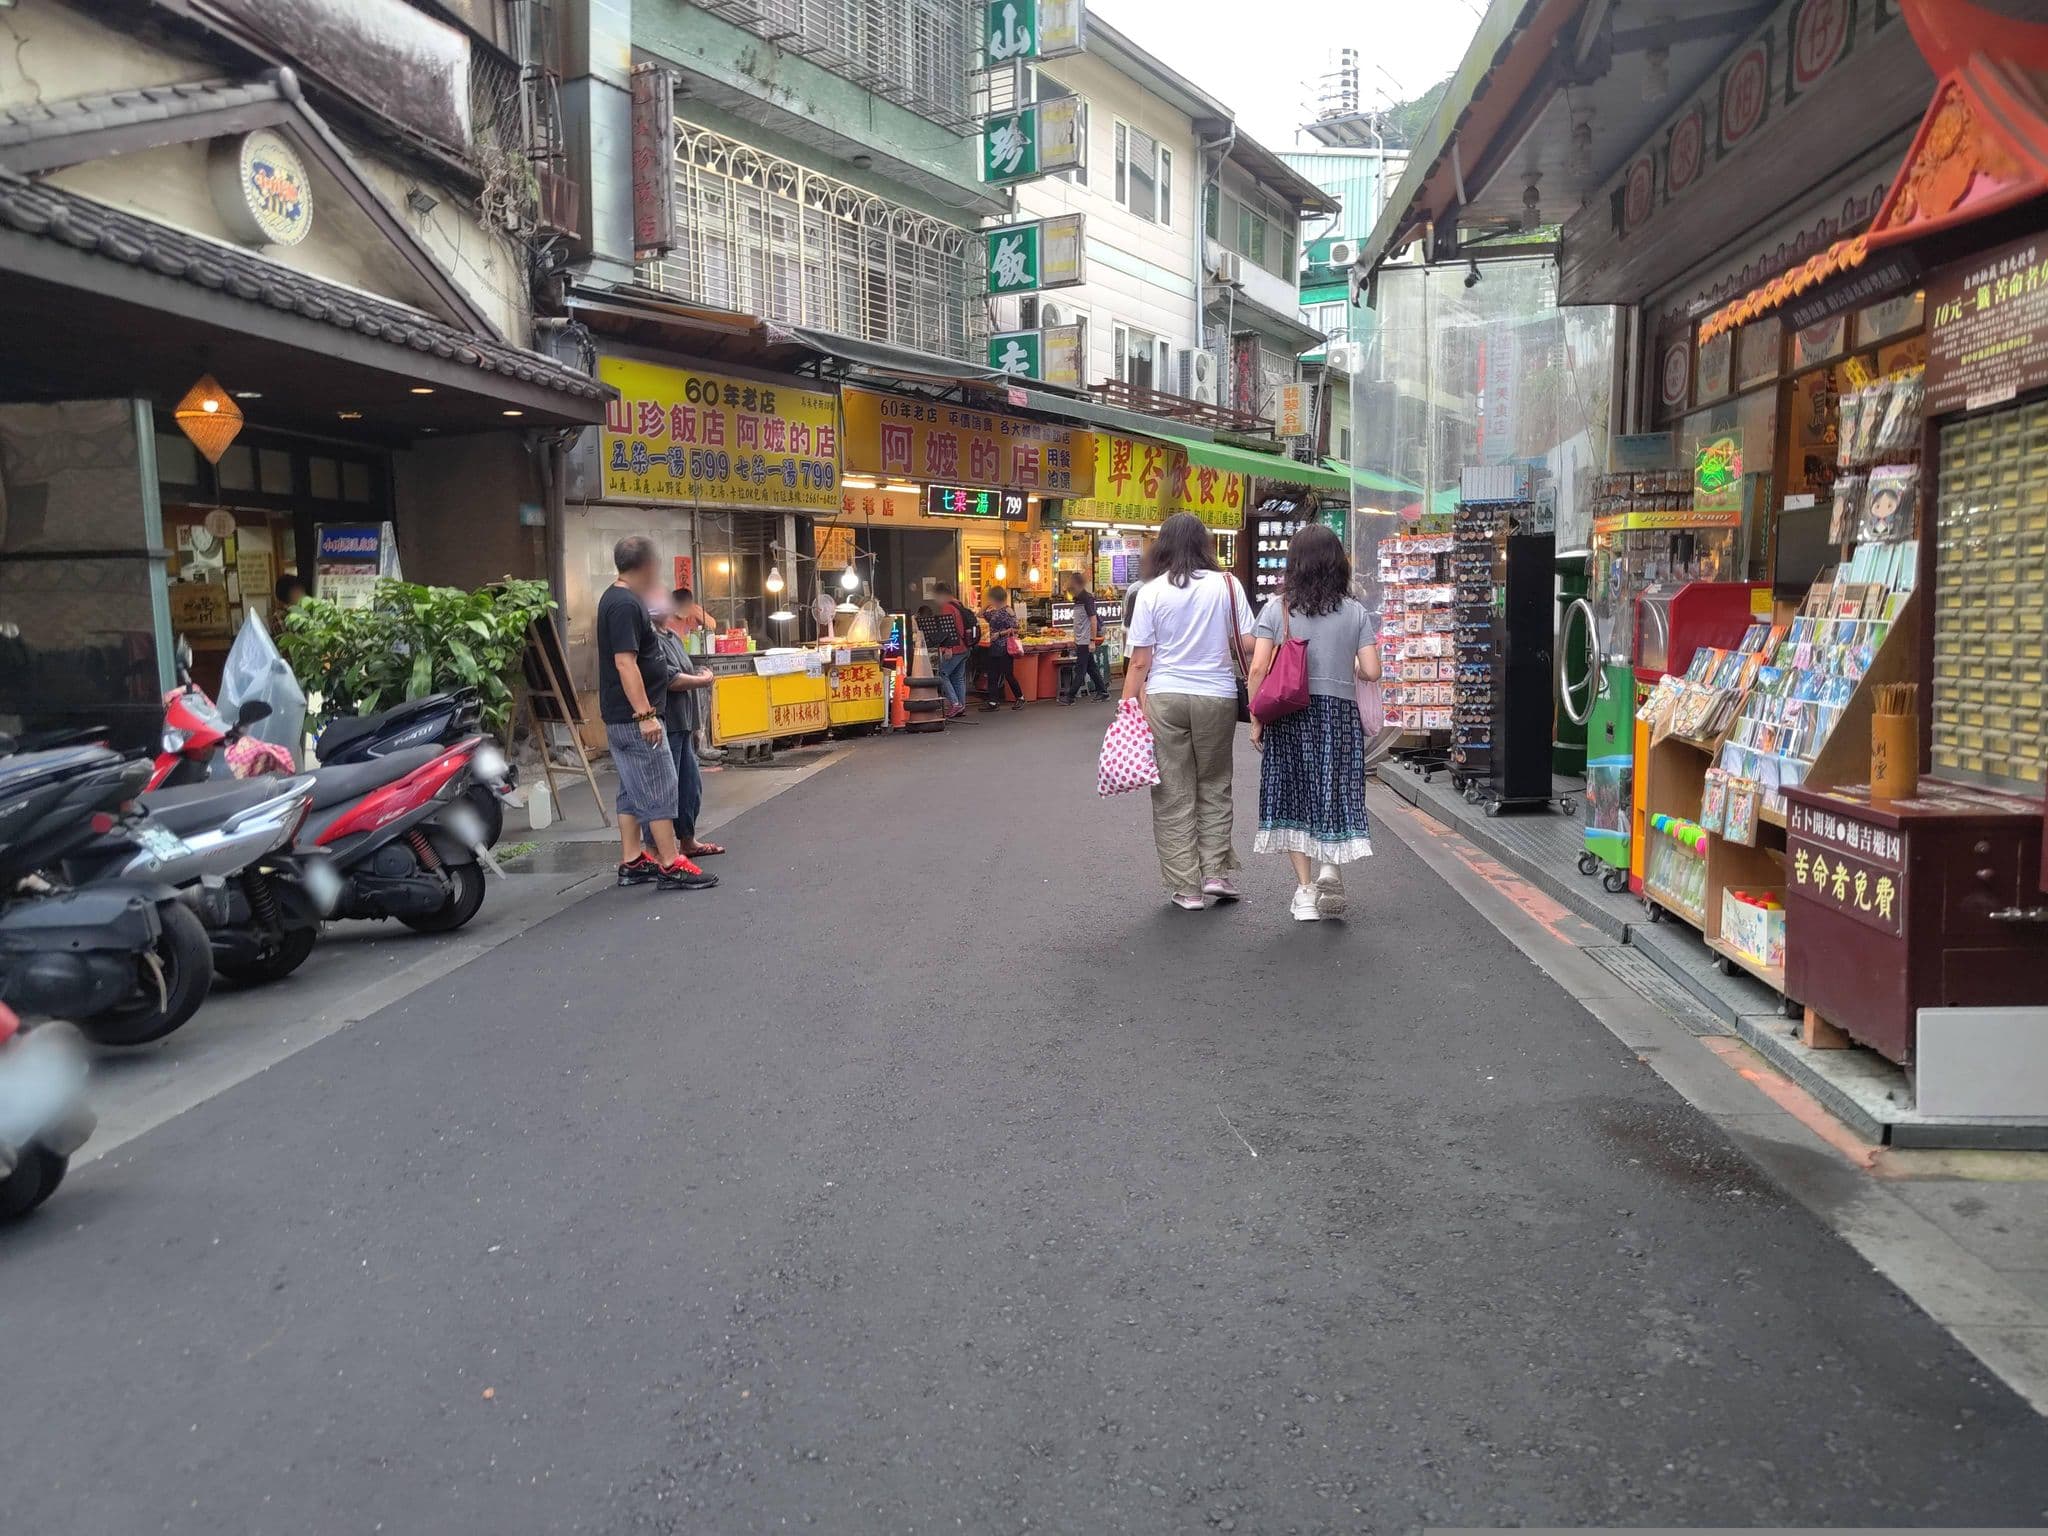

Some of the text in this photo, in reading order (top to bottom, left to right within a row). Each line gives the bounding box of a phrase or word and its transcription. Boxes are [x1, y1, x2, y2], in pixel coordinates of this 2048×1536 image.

[685, 377, 776, 415] 60年老店
[880, 399, 938, 423] 60年老店
[605, 400, 835, 459] 山珍飯店 阿嬤的店
[610, 441, 835, 491] 五菜一湯 599 七菜一湯 799
[881, 422, 1041, 488] 阿嬤的店
[1094, 439, 1240, 509] 翠谷飲食店
[942, 489, 1022, 514] 七菜一湯 799
[1641, 513, 1675, 522] Press
[1692, 511, 1732, 522] Penny
[1792, 804, 1836, 841] 占卜開運
[1794, 847, 1895, 921] 苦命者免費
